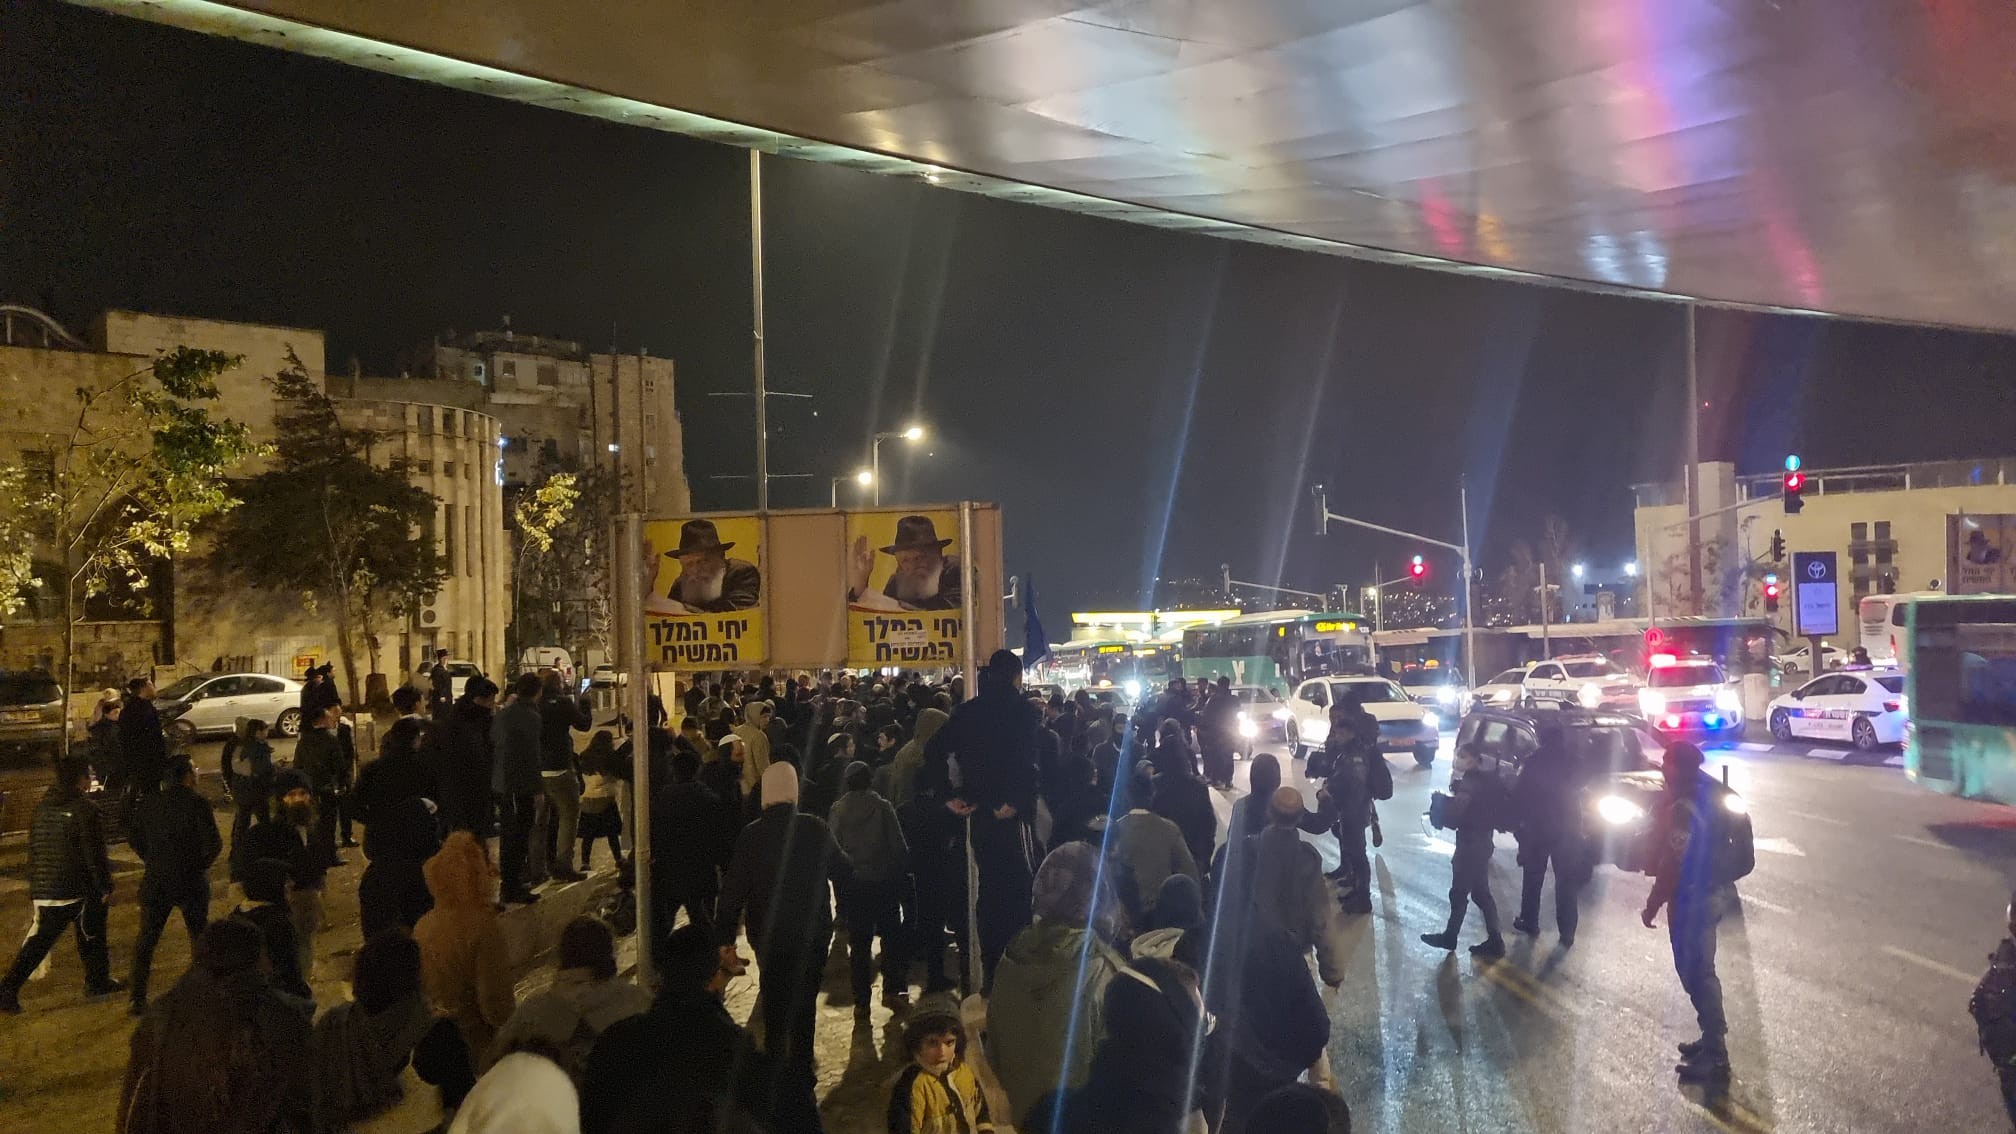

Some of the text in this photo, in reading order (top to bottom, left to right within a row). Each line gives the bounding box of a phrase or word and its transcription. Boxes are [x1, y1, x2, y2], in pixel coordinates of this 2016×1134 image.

[649, 619, 748, 646] יחי המלך
[662, 643, 738, 664] המשיח
[877, 640, 954, 662] המשיח
